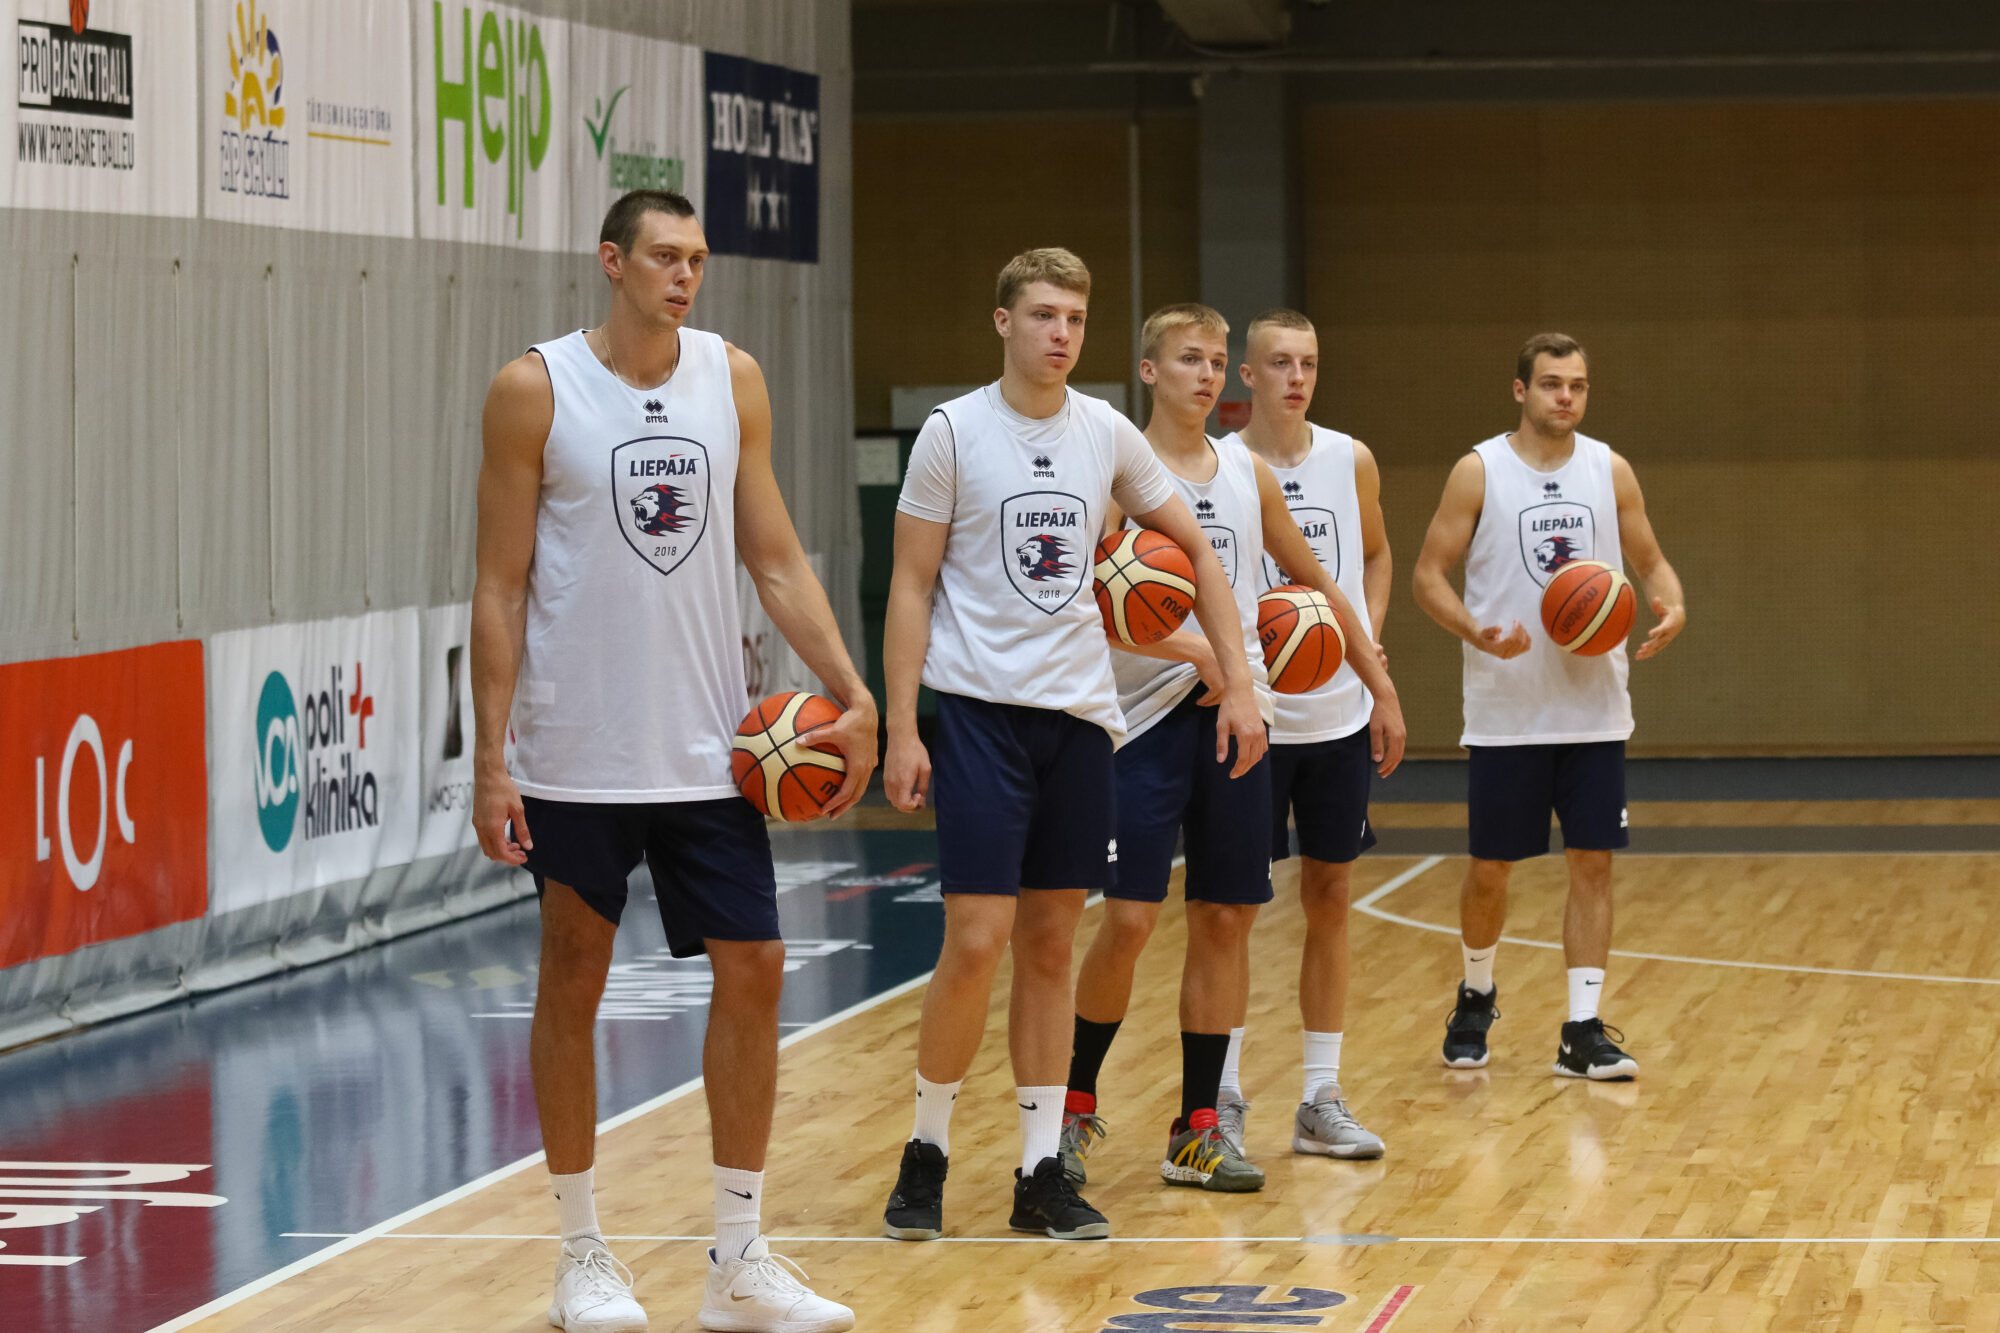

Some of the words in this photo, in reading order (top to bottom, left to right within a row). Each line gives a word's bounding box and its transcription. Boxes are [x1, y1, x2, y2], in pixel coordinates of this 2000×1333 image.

[645, 415, 669, 424] errea
[1033, 470, 1055, 478] errea
[654, 546, 677, 557] 2018
[1038, 590, 1061, 600] 2018
[305, 665, 344, 750] poli
